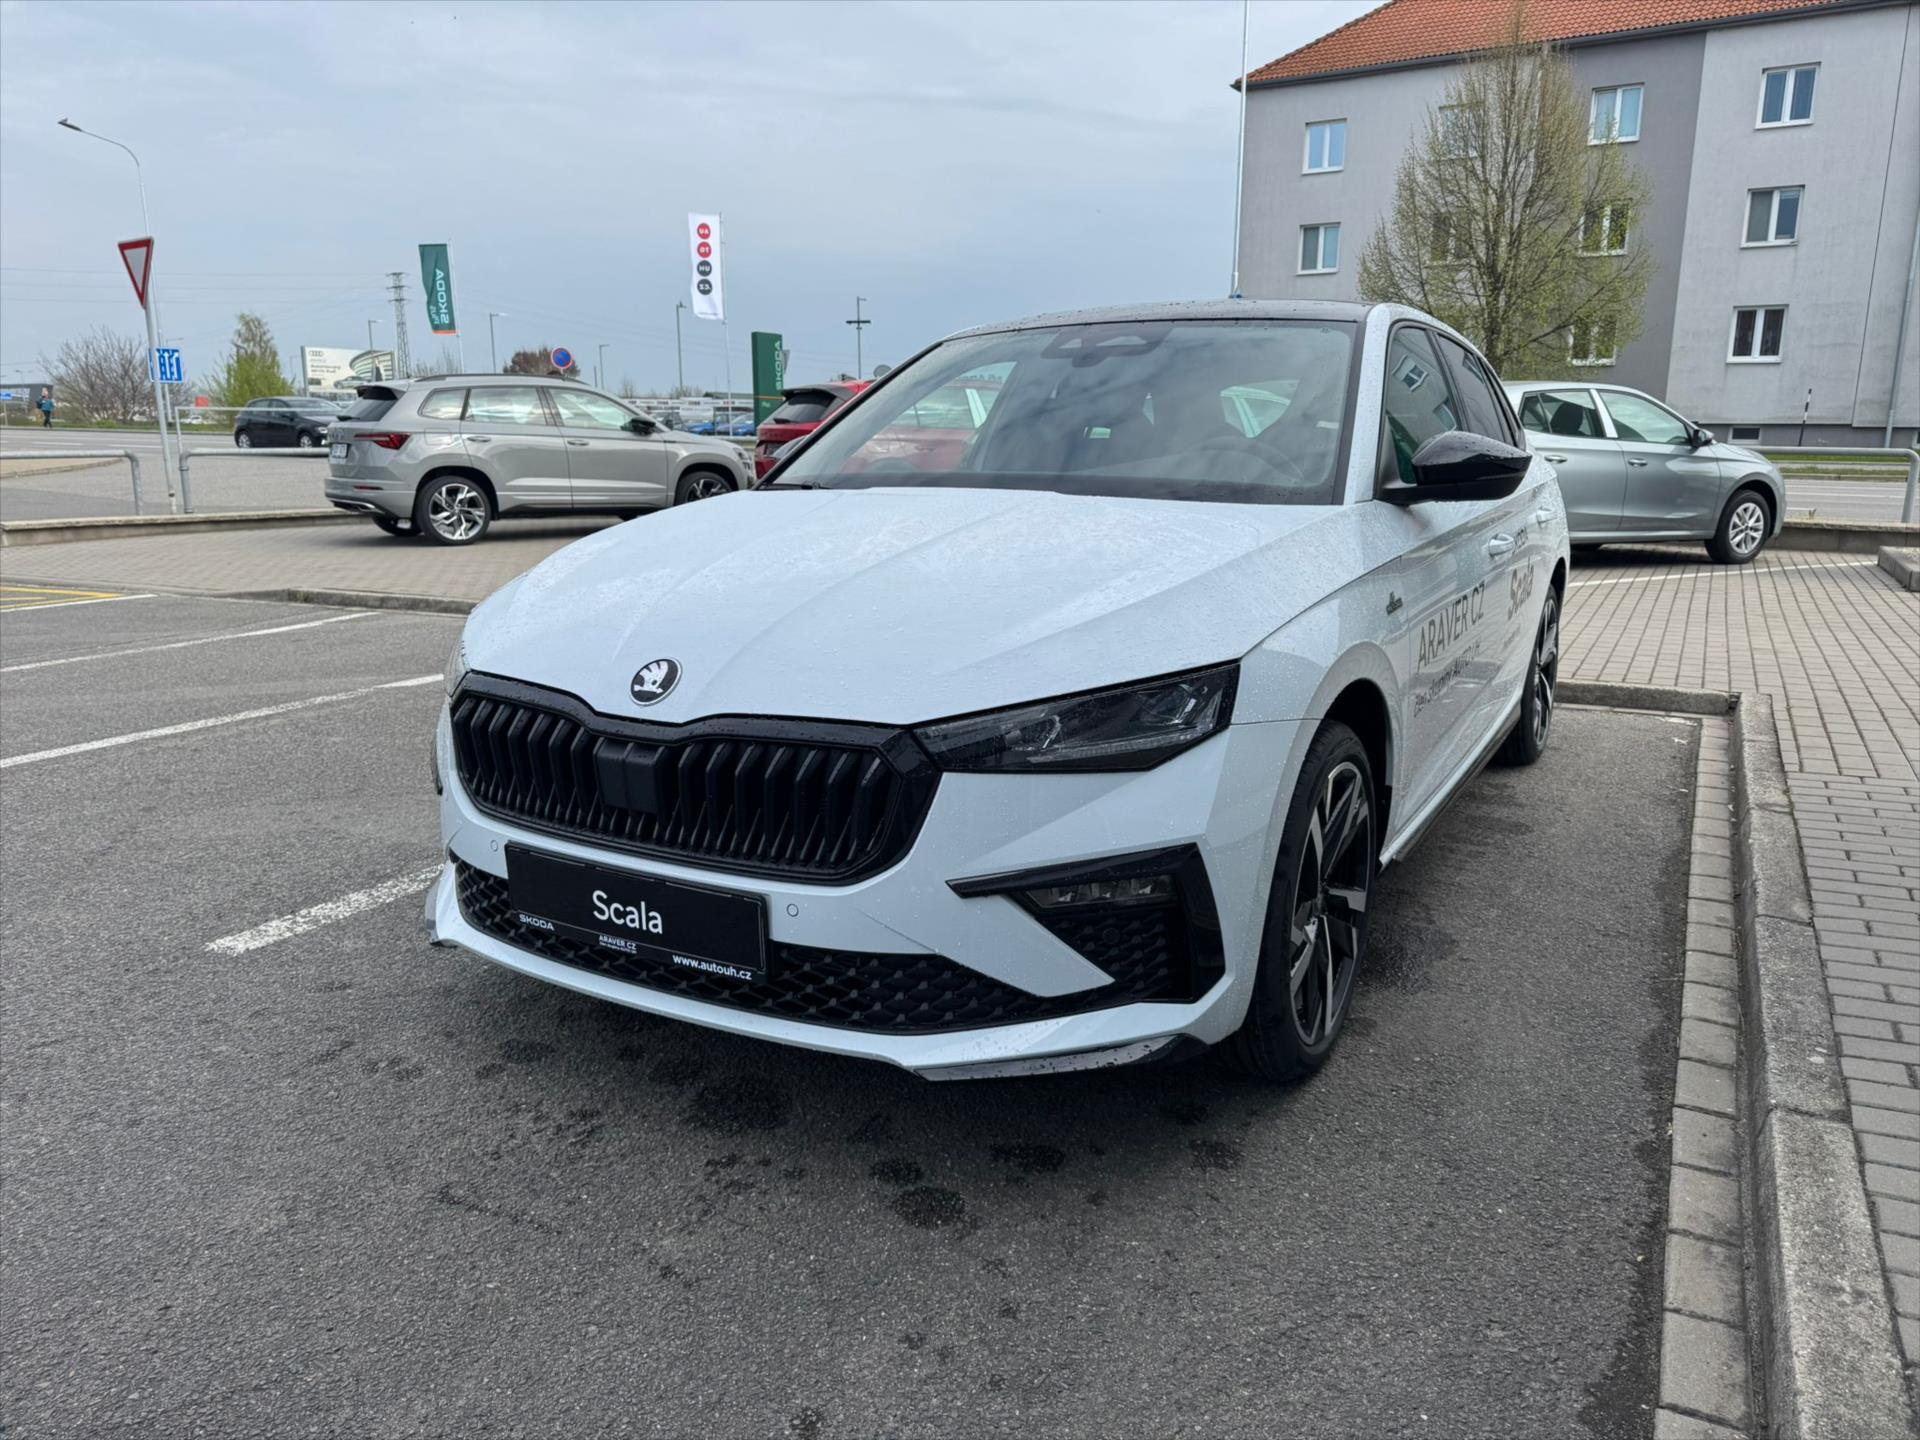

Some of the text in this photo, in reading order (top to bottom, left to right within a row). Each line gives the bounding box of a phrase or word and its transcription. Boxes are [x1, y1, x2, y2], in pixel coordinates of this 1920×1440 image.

[1417, 594, 1469, 673] ARAVER
[1471, 580, 1485, 626] CZ
[518, 913, 555, 932] SKODA
[592, 889, 664, 935] Scala
[599, 934, 626, 948] ARAVER
[626, 941, 637, 951] CZ
[672, 954, 752, 981] www.autouh.cz
